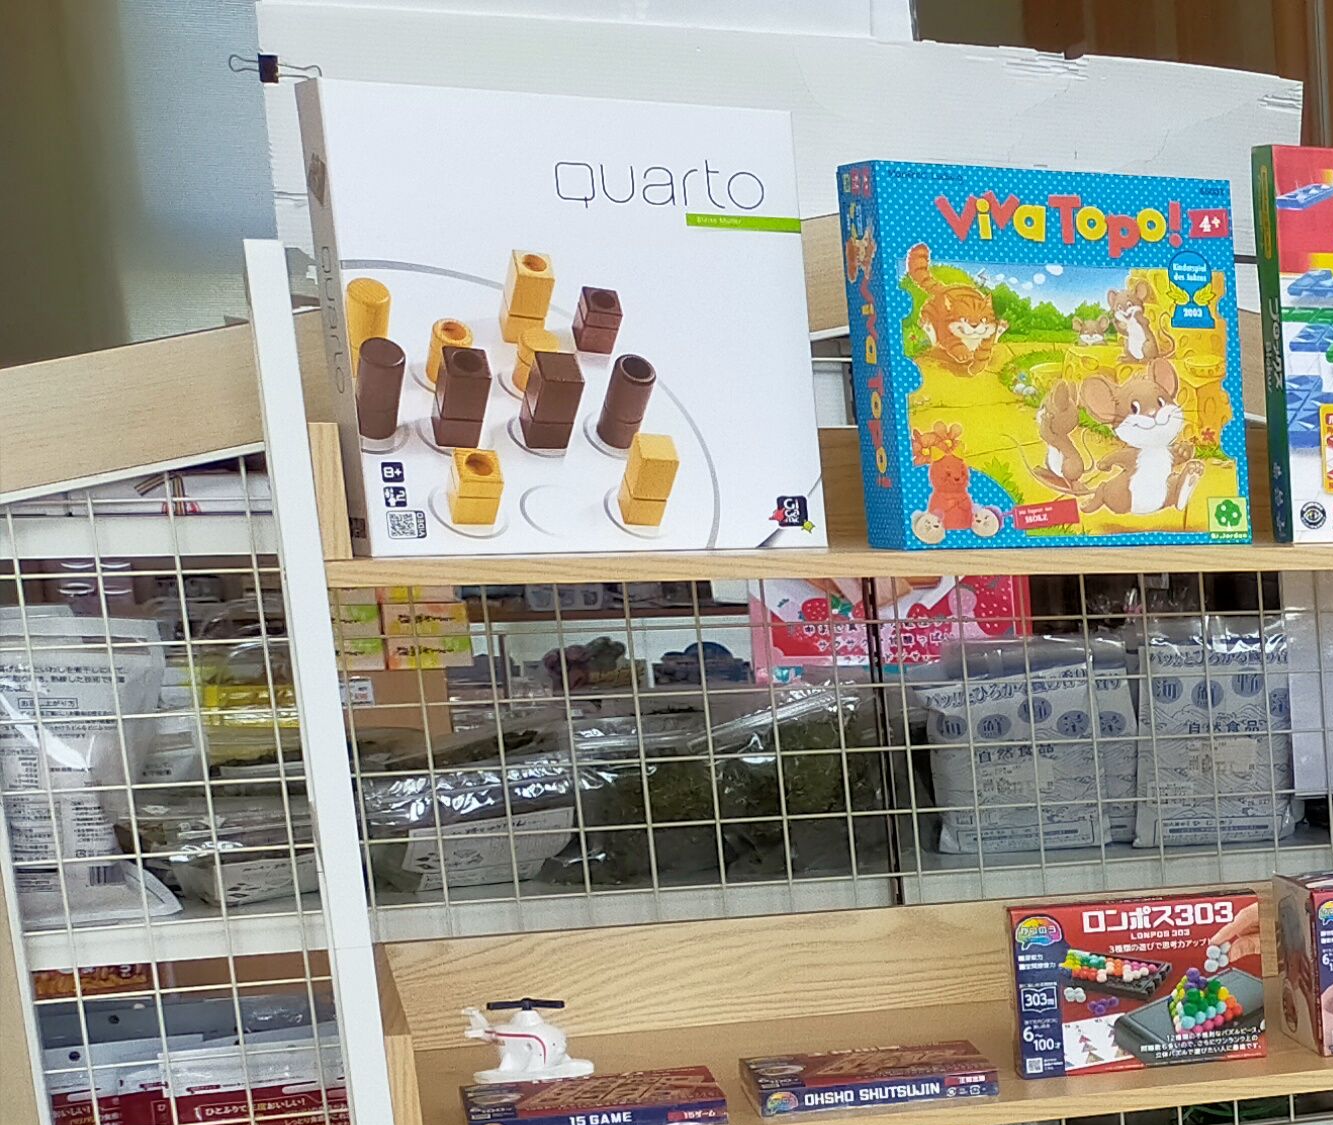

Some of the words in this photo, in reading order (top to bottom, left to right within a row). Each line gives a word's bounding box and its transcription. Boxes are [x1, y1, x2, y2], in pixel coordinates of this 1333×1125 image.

[1199, 215, 1221, 233] 4+
[1082, 901, 1234, 934] ロンポス303
[1171, 928, 1191, 938] 303
[804, 1090, 854, 1106] OHSHO
[859, 1082, 940, 1101] SHUTSUJIN
[589, 1111, 632, 1125] GAME
